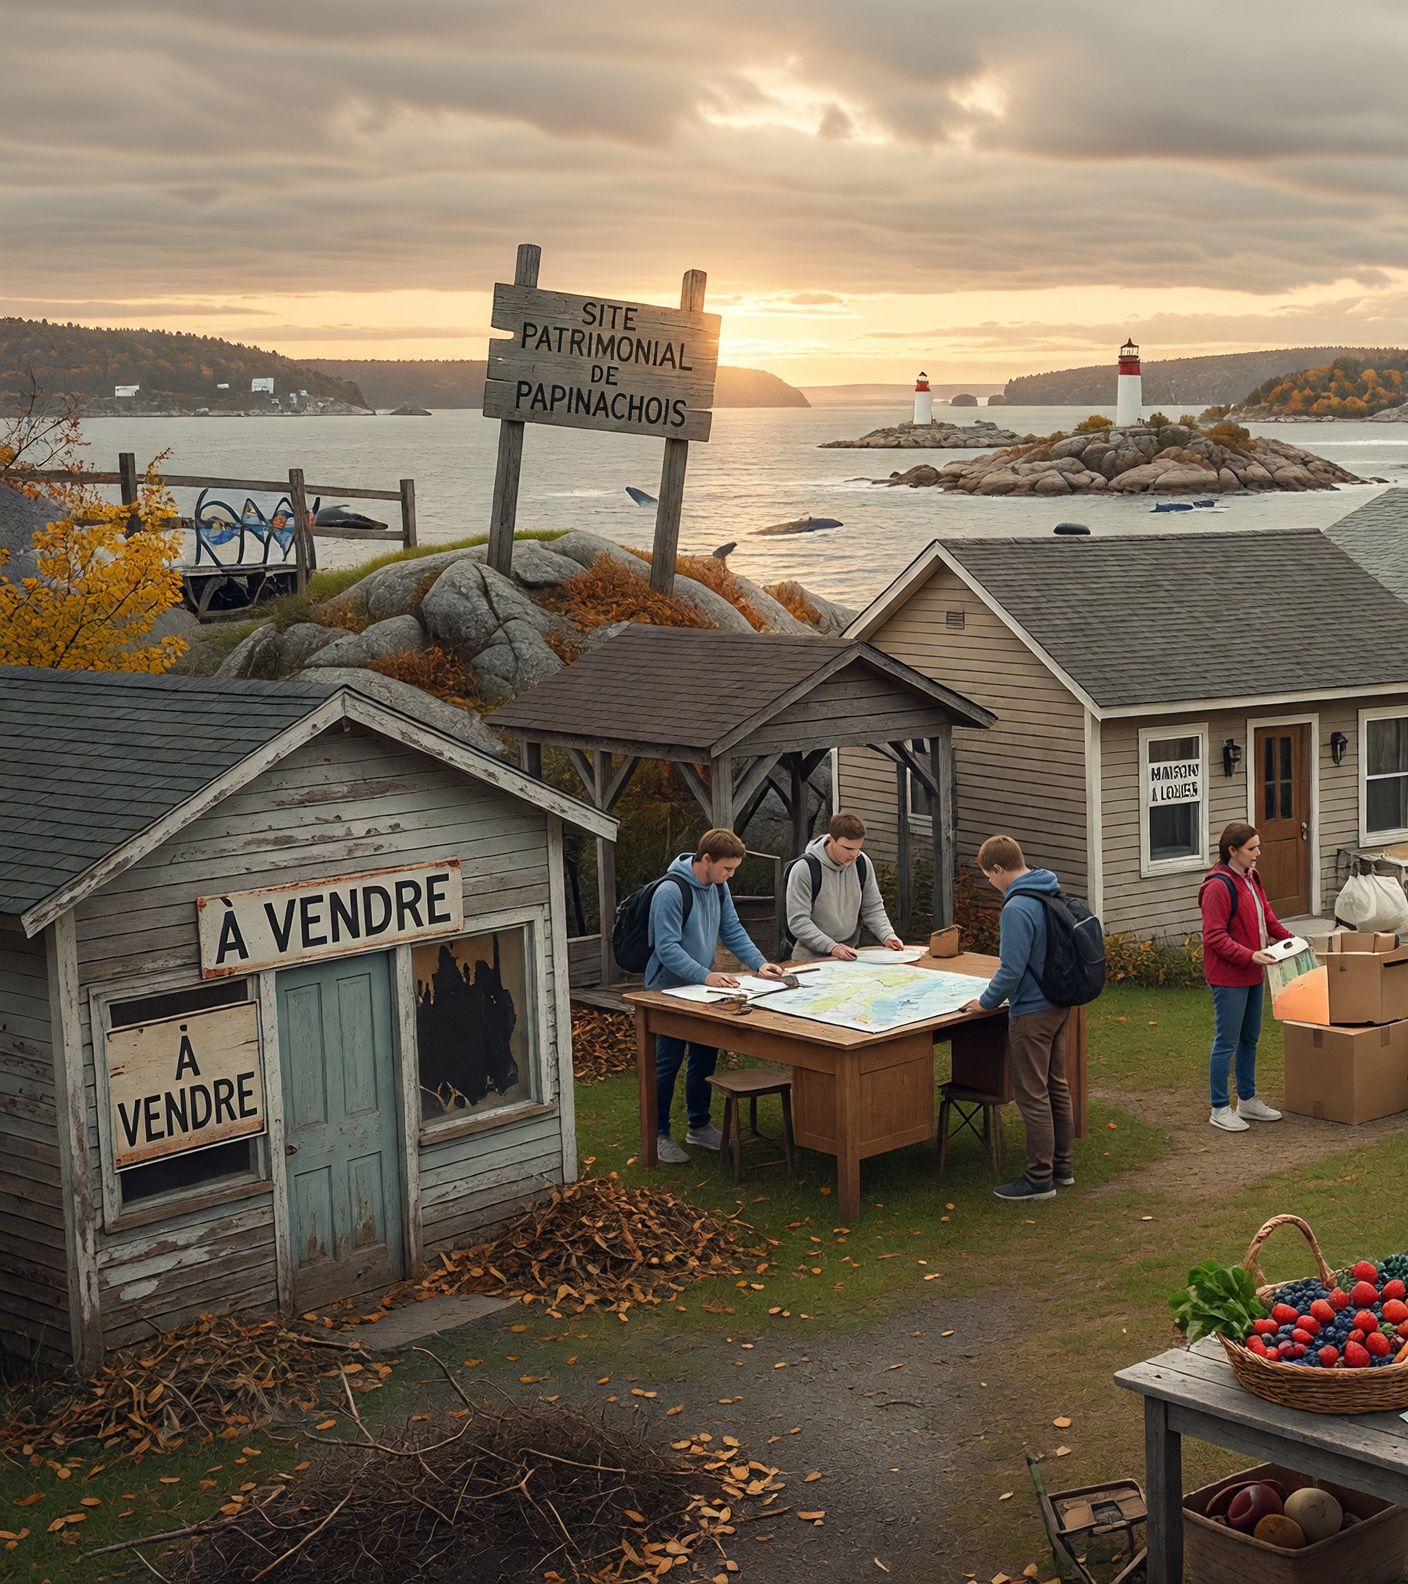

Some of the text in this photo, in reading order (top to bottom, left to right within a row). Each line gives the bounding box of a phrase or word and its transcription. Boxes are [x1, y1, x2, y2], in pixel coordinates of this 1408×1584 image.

[582, 301, 638, 332] SITE
[521, 322, 693, 371] PATRIMONIAL
[590, 364, 619, 386] DE
[515, 381, 687, 427] PAPINACHOIS
[215, 873, 452, 965] À VENDRE
[117, 1071, 258, 1148] VENDRE
